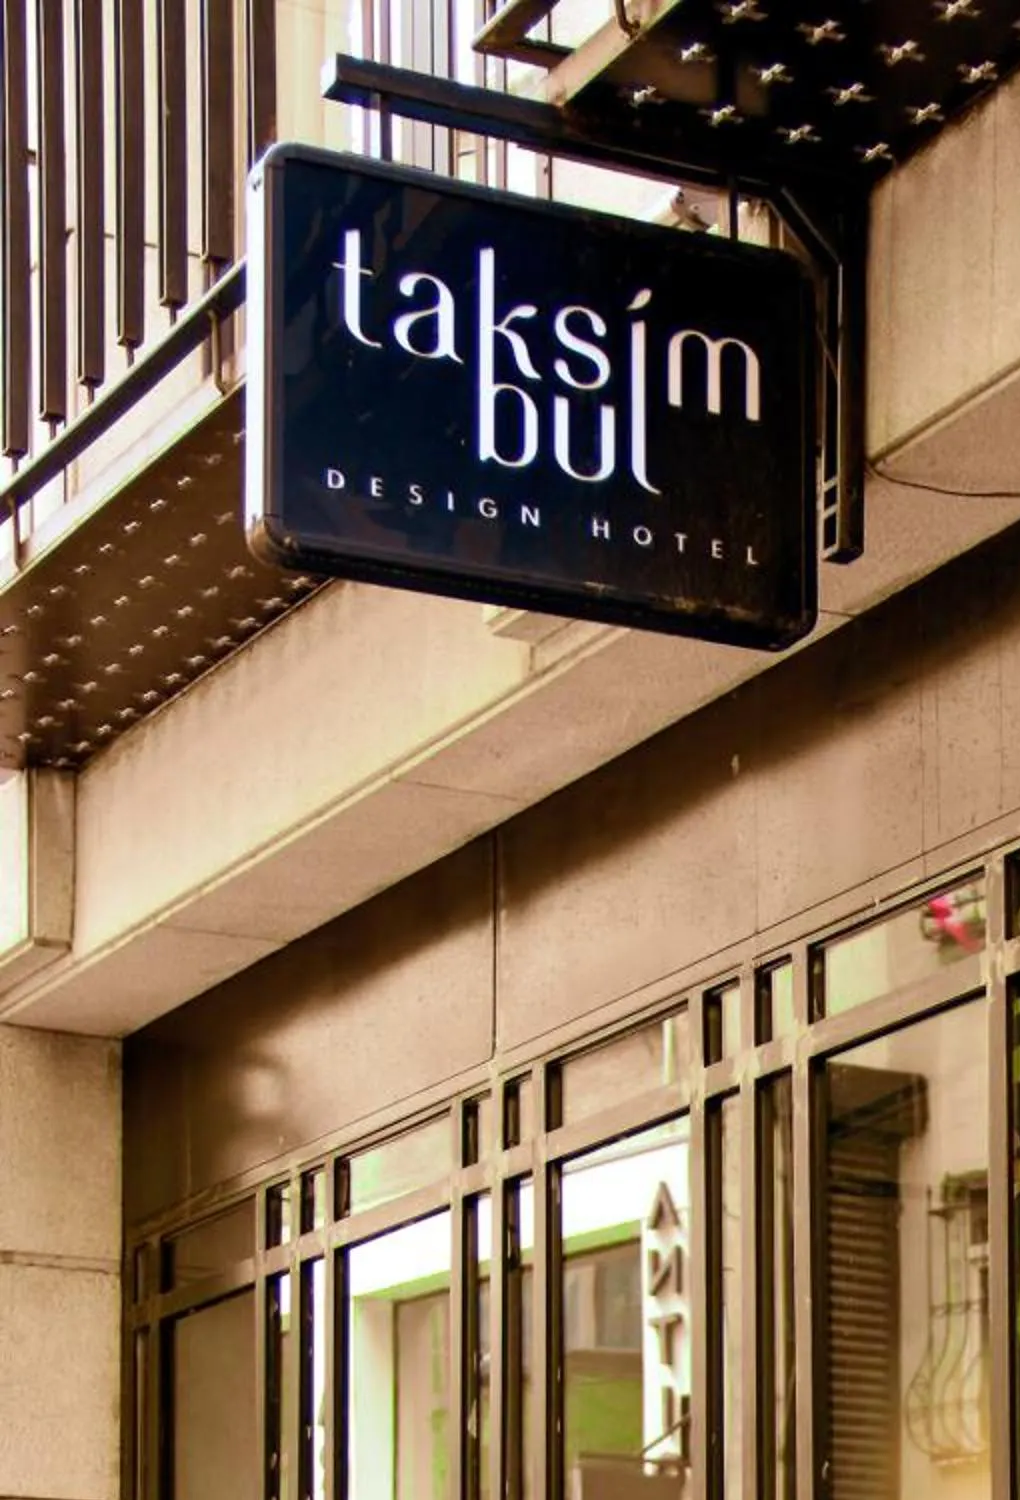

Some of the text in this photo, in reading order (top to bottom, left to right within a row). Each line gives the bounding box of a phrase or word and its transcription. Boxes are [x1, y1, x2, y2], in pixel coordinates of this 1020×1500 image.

[478, 376, 662, 495] bul
[326, 468, 759, 566] DESIGN HOTEL
